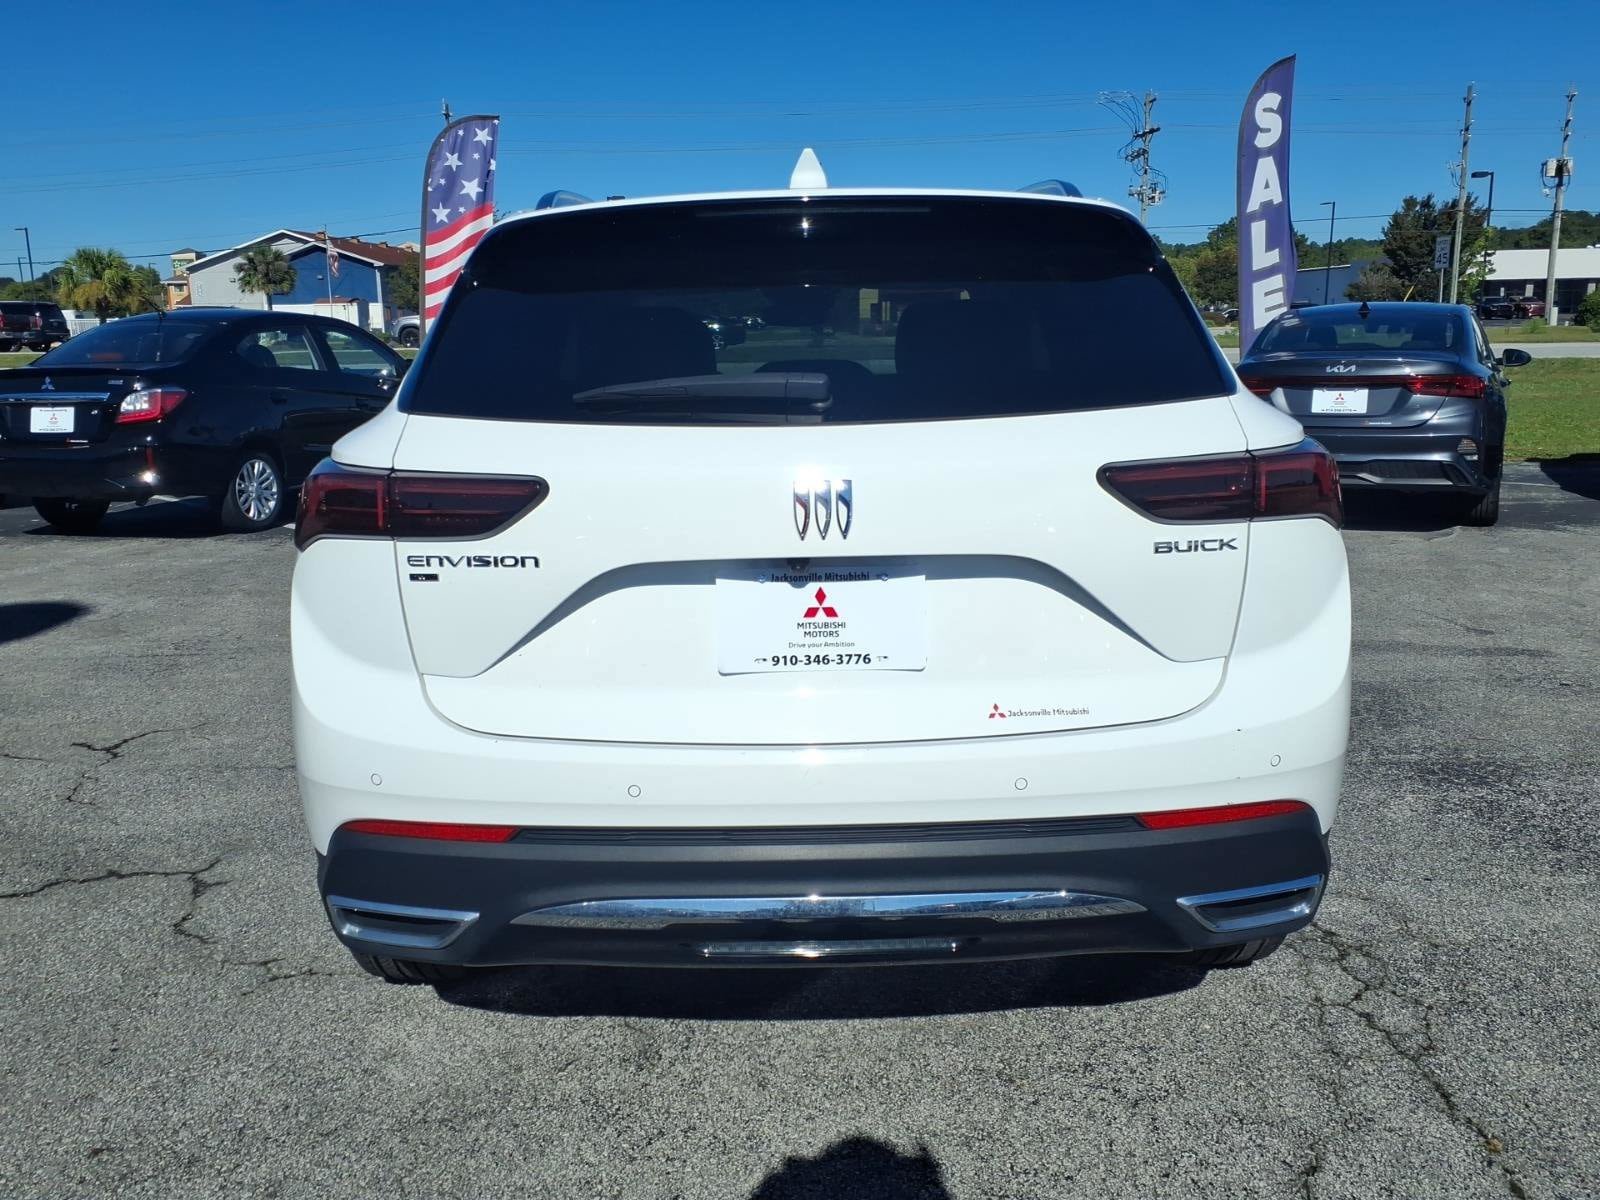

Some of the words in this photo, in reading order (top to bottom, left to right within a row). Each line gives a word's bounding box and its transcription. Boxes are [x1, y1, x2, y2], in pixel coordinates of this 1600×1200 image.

[1246, 92, 1288, 330] SALE
[1436, 252, 1448, 264] 45
[1153, 538, 1238, 554] BUICK
[407, 555, 540, 568] ENVISION
[771, 573, 823, 583] Jacksonville
[824, 572, 870, 582] Mitsubishi
[796, 621, 846, 630] MITSUBISHI
[803, 630, 840, 638] MOTORS
[807, 642, 823, 650] your
[824, 640, 855, 648] Ambition
[771, 654, 872, 666] 910-346-3776
[1008, 708, 1051, 717] Jacksonville
[1052, 707, 1089, 715] Mitsubishi
